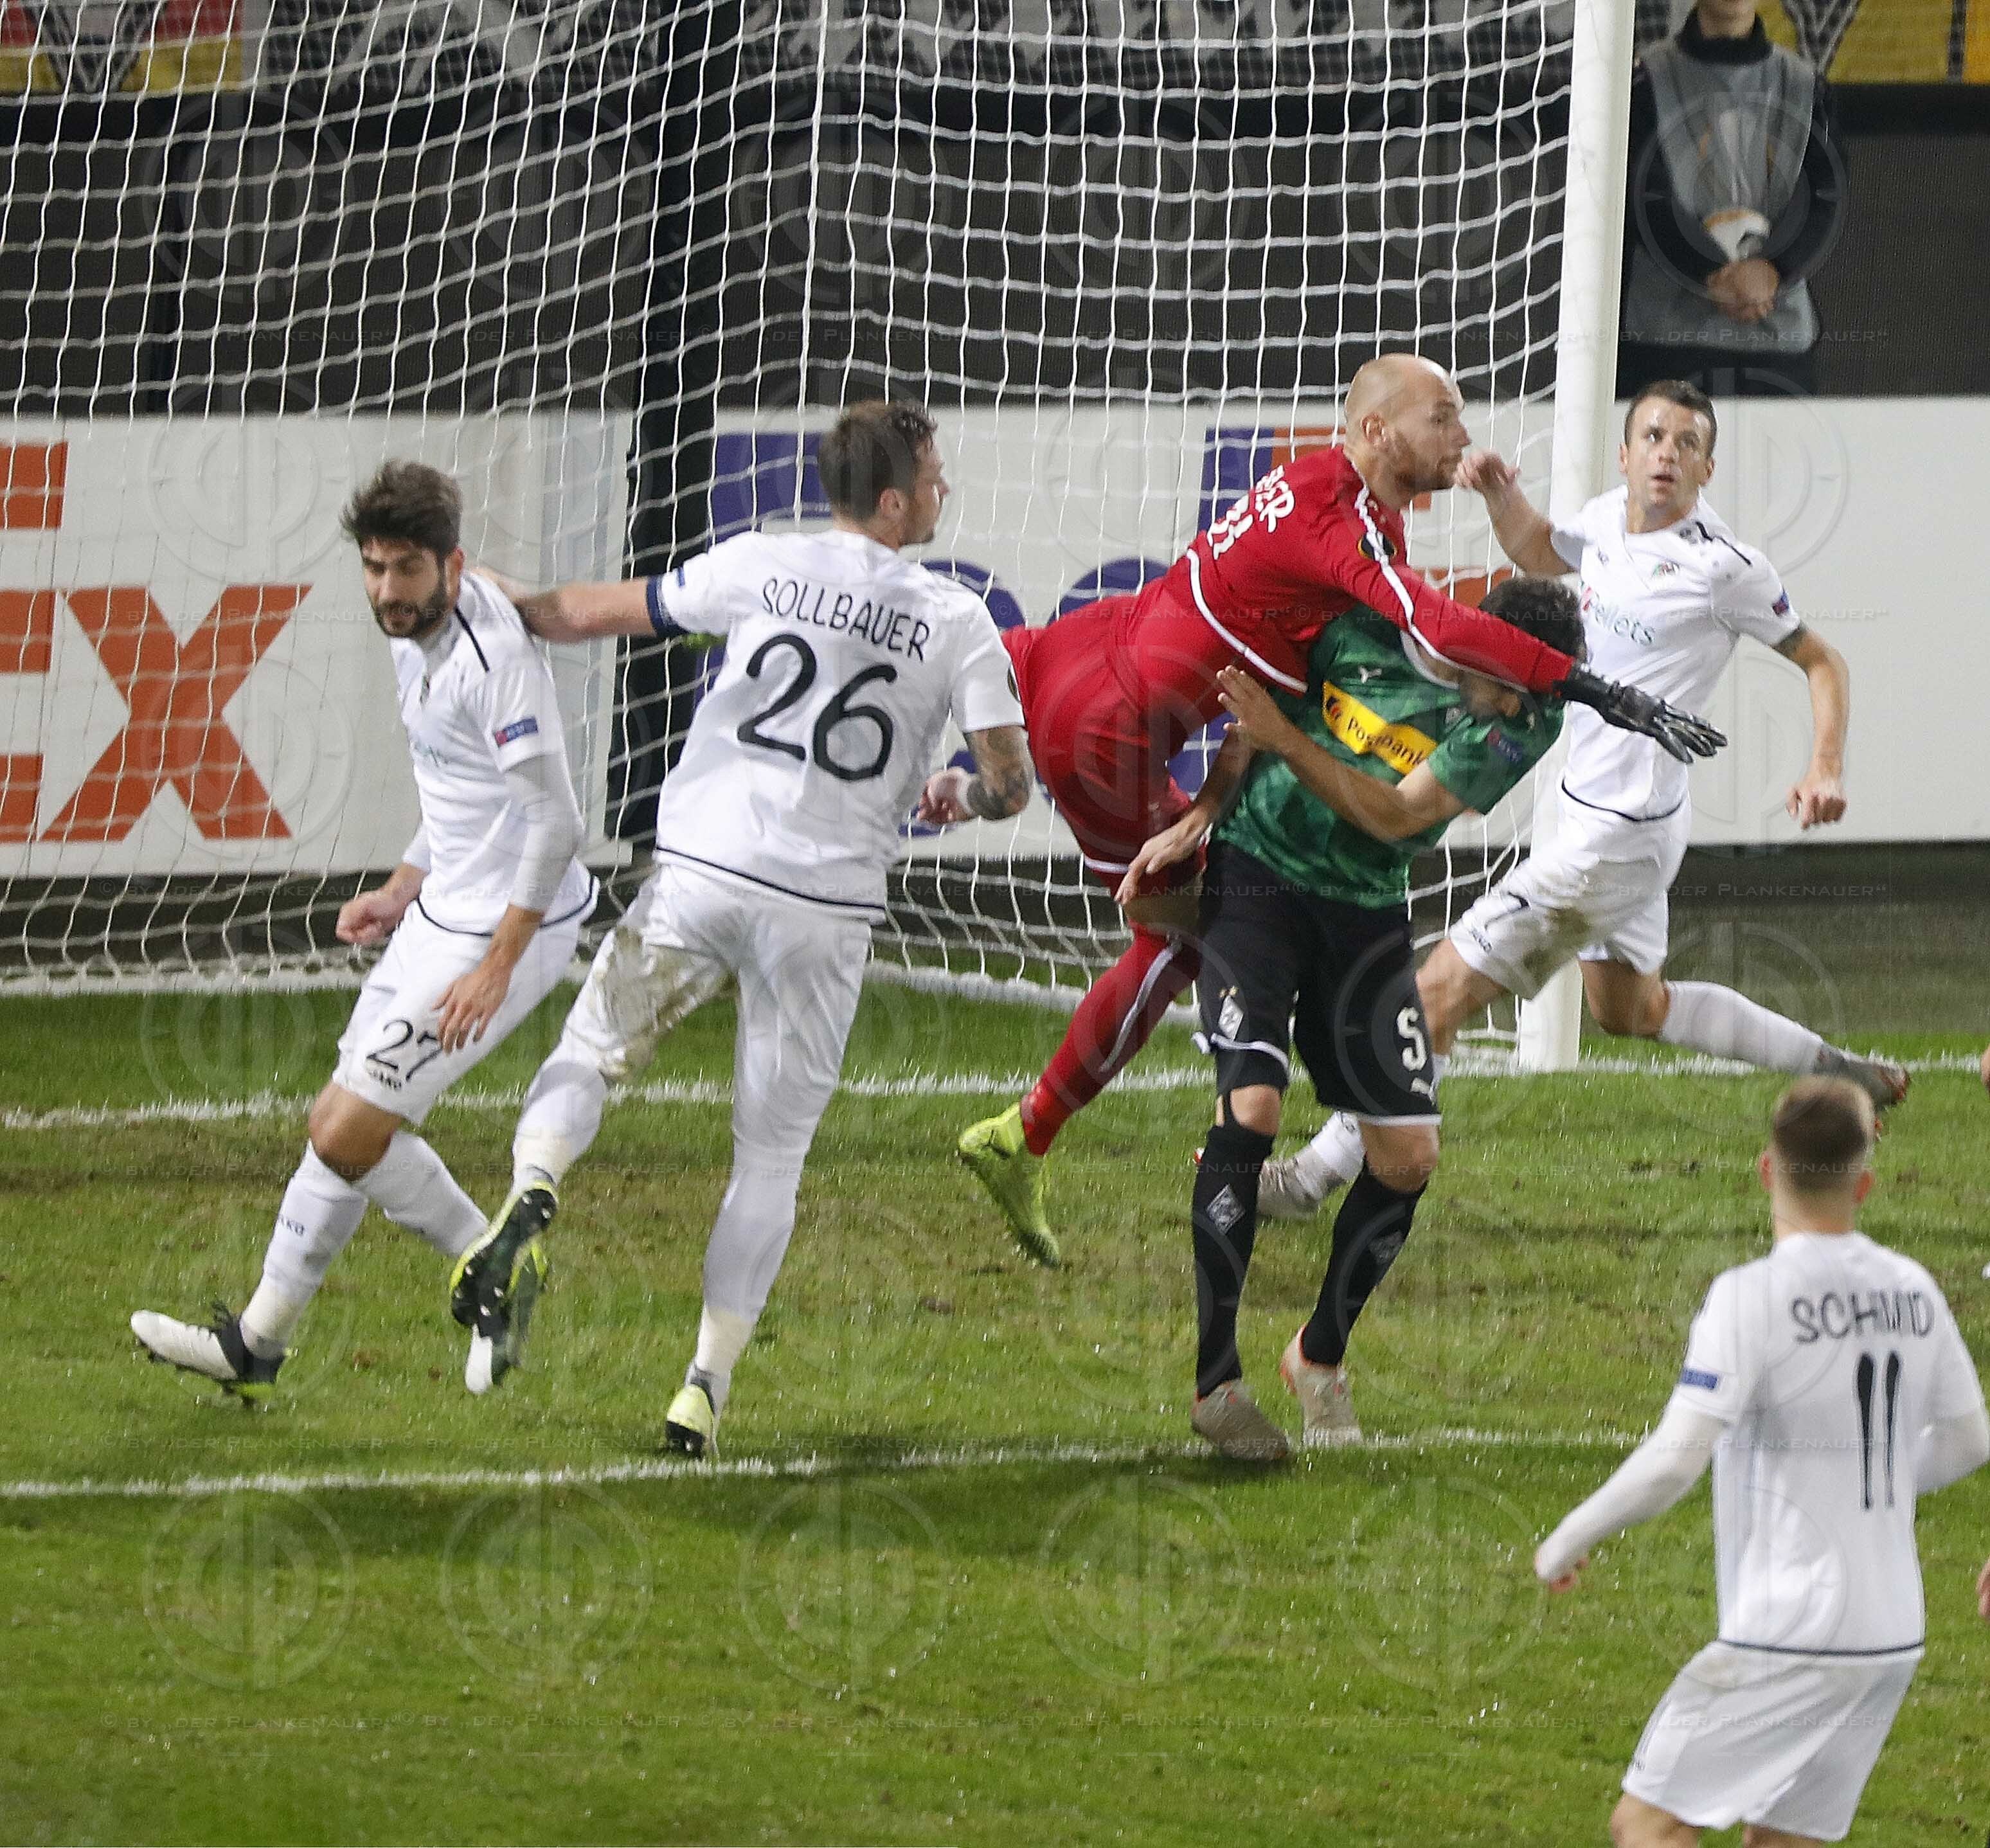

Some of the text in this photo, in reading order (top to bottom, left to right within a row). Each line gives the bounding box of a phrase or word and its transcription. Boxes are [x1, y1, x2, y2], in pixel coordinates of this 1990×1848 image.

[762, 577, 930, 663] SOLLBAUER
[737, 634, 899, 782] 26
[366, 1019, 443, 1081] 27
[1856, 1350, 1901, 1511] 11
